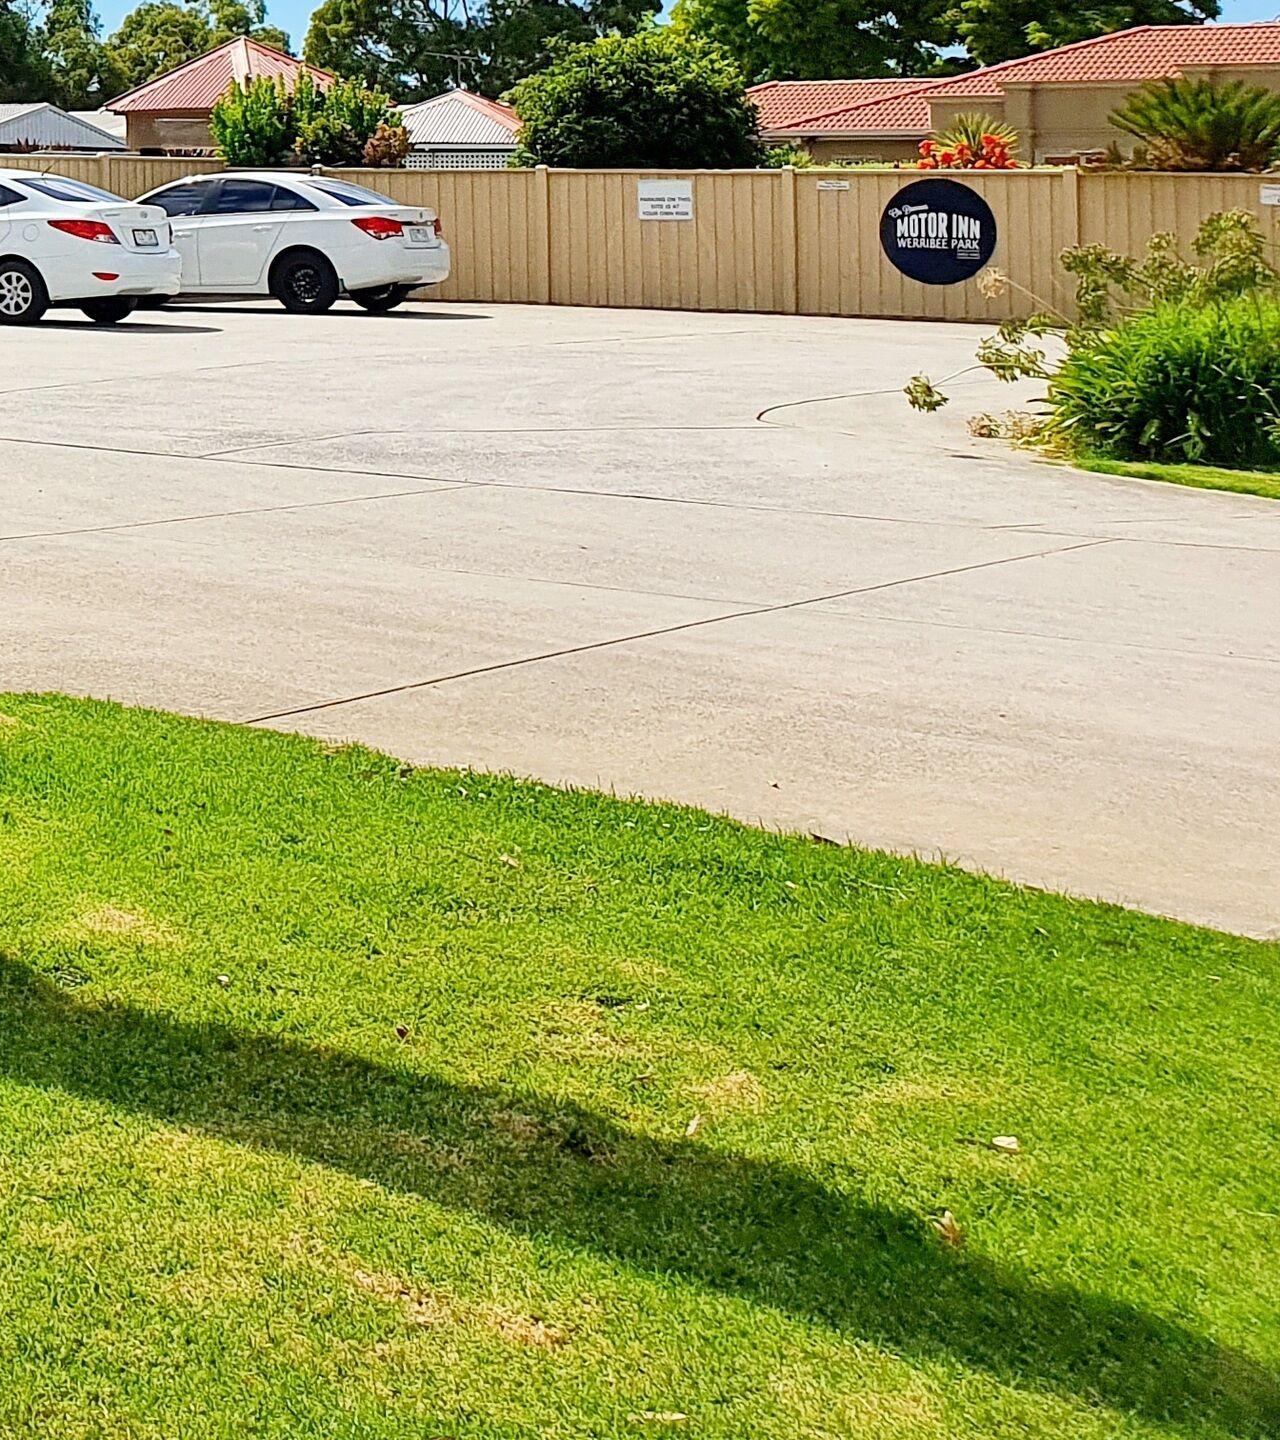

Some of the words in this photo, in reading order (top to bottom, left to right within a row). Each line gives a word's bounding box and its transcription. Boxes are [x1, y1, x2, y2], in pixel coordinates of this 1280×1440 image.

[896, 212, 948, 238] MOTOR
[951, 213, 980, 239] INN
[897, 238, 949, 249] WERRIBEE
[951, 239, 980, 250] PARK
